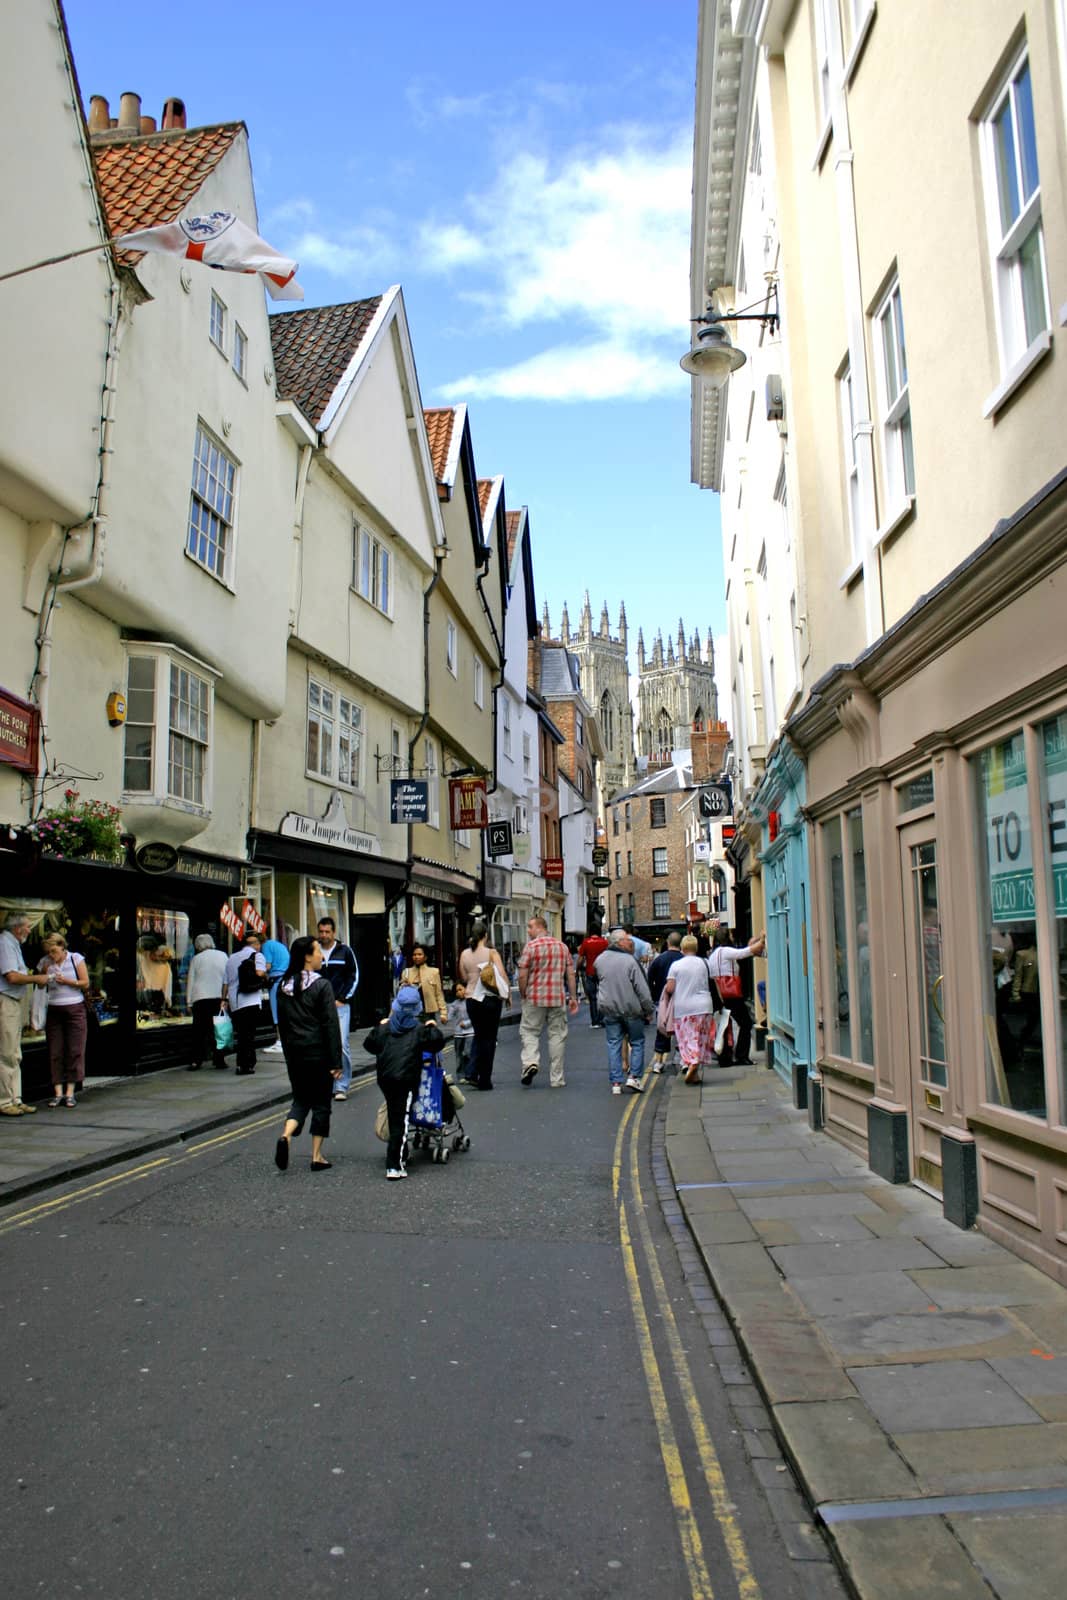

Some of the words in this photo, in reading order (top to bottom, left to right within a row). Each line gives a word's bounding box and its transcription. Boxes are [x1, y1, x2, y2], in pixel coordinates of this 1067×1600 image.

[12, 716, 28, 734] PORK
[403, 784, 417, 793] The
[391, 803, 426, 812] Company
[394, 794, 424, 803] Jumper
[295, 816, 310, 834] The
[312, 821, 342, 844] Jumper
[343, 829, 373, 851] Company
[493, 830, 506, 844] PS
[991, 811, 1022, 863] TO
[220, 903, 244, 938] SALE
[244, 903, 265, 934] SALE
